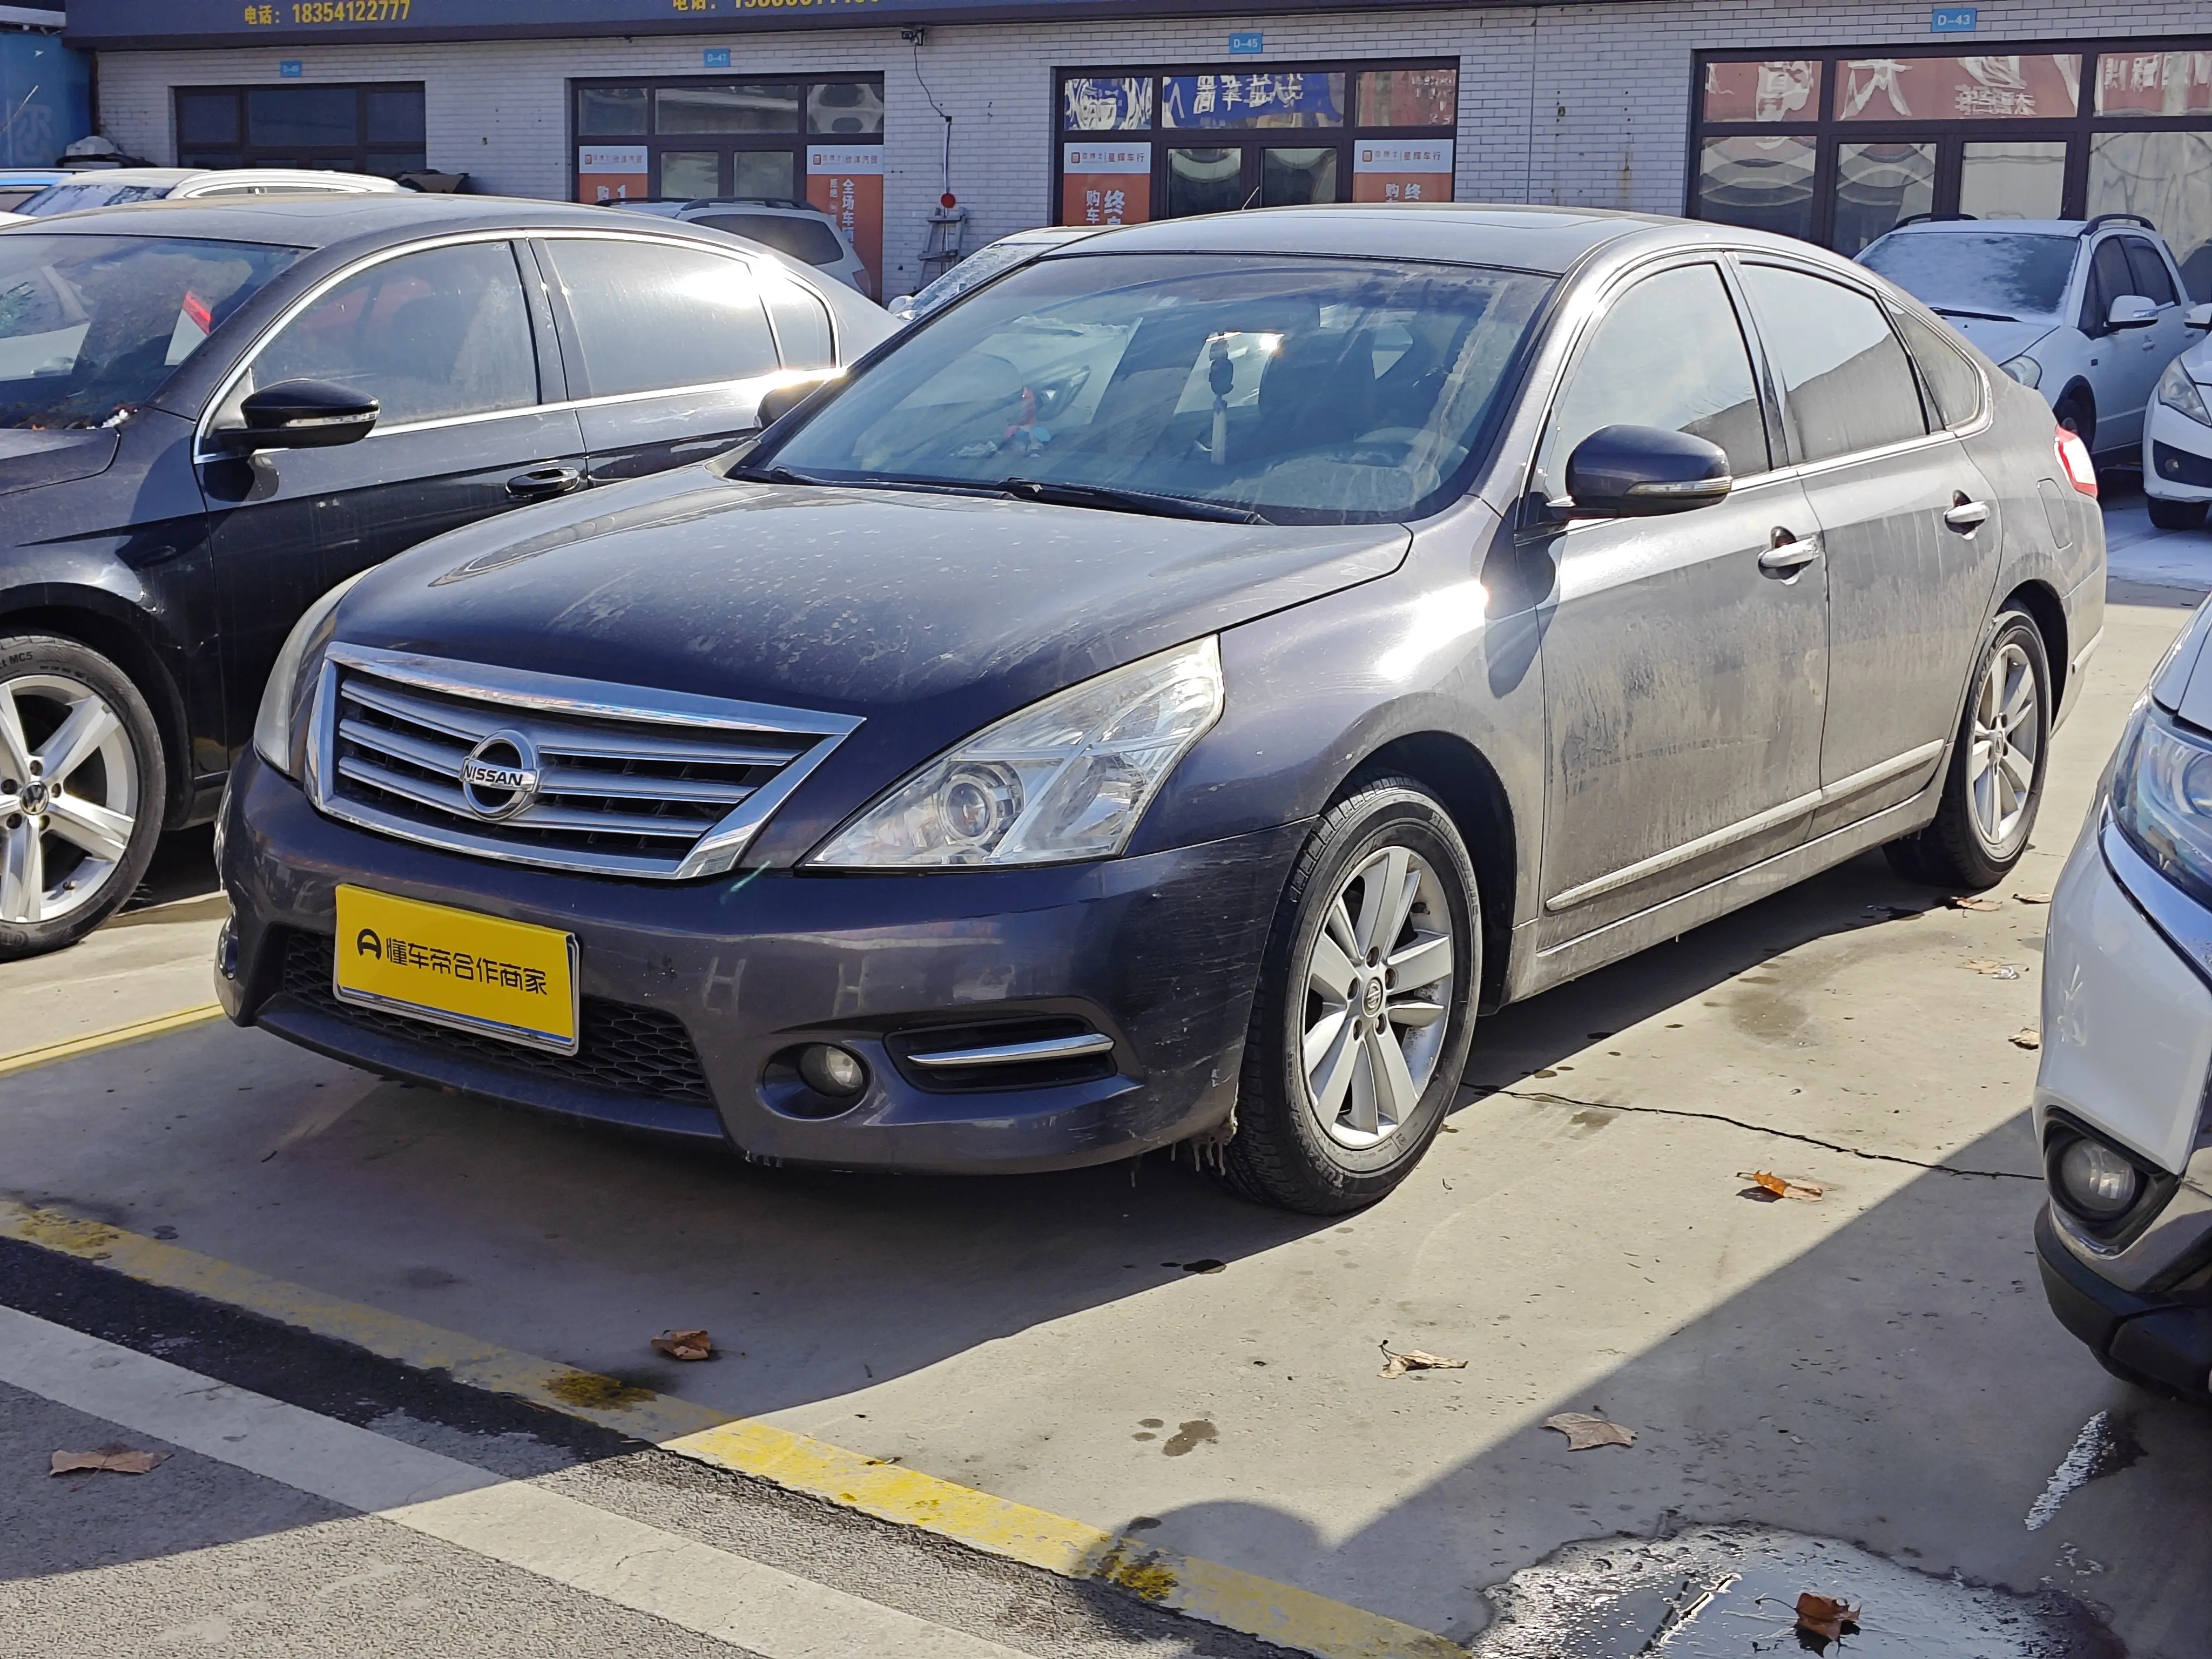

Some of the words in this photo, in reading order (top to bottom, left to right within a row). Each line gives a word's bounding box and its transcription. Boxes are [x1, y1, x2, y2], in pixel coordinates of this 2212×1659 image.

[292, 0, 413, 23] 18354122777
[1938, 14, 1971, 25] D-43
[1233, 38, 1258, 48] D-45
[707, 53, 727, 63] D-47
[1086, 190, 1100, 224] 购车
[9, 651, 33, 665] MC5
[463, 765, 523, 786] NISSAN
[386, 937, 548, 996] 懂车帝合作商家
